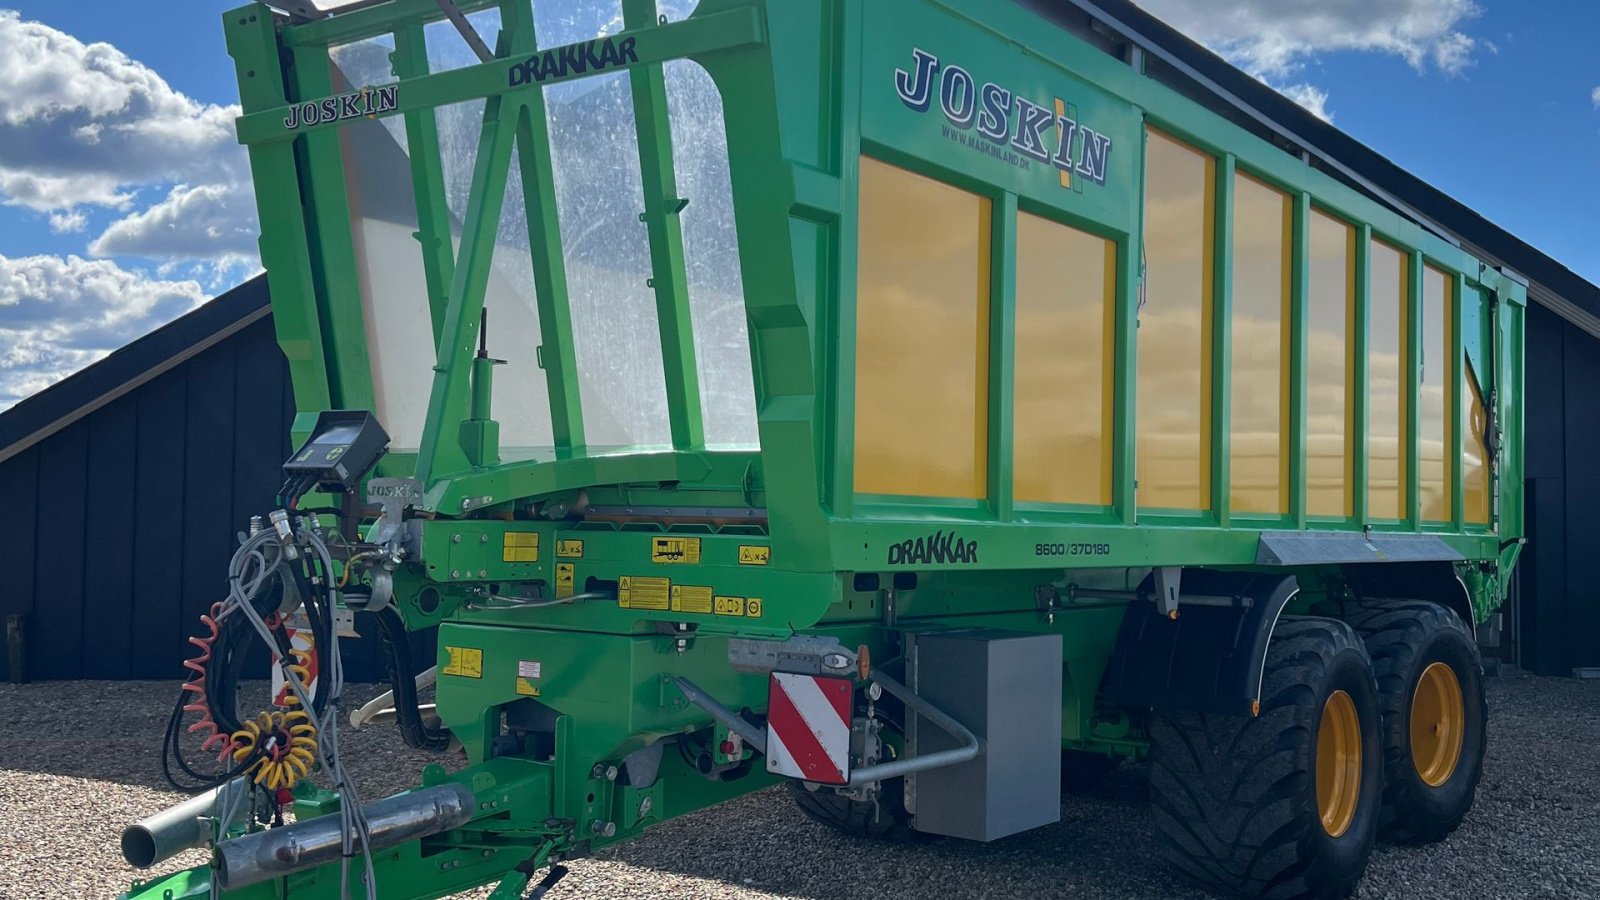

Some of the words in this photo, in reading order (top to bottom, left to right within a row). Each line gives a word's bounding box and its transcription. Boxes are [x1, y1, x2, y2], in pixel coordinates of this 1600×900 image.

[508, 36, 639, 87] DRAKKAR
[284, 85, 399, 130] JOSKIN
[895, 47, 1112, 187] JOSKIN
[887, 528, 978, 565] DRAKKAR
[1035, 542, 1110, 556] 8600/37D180
